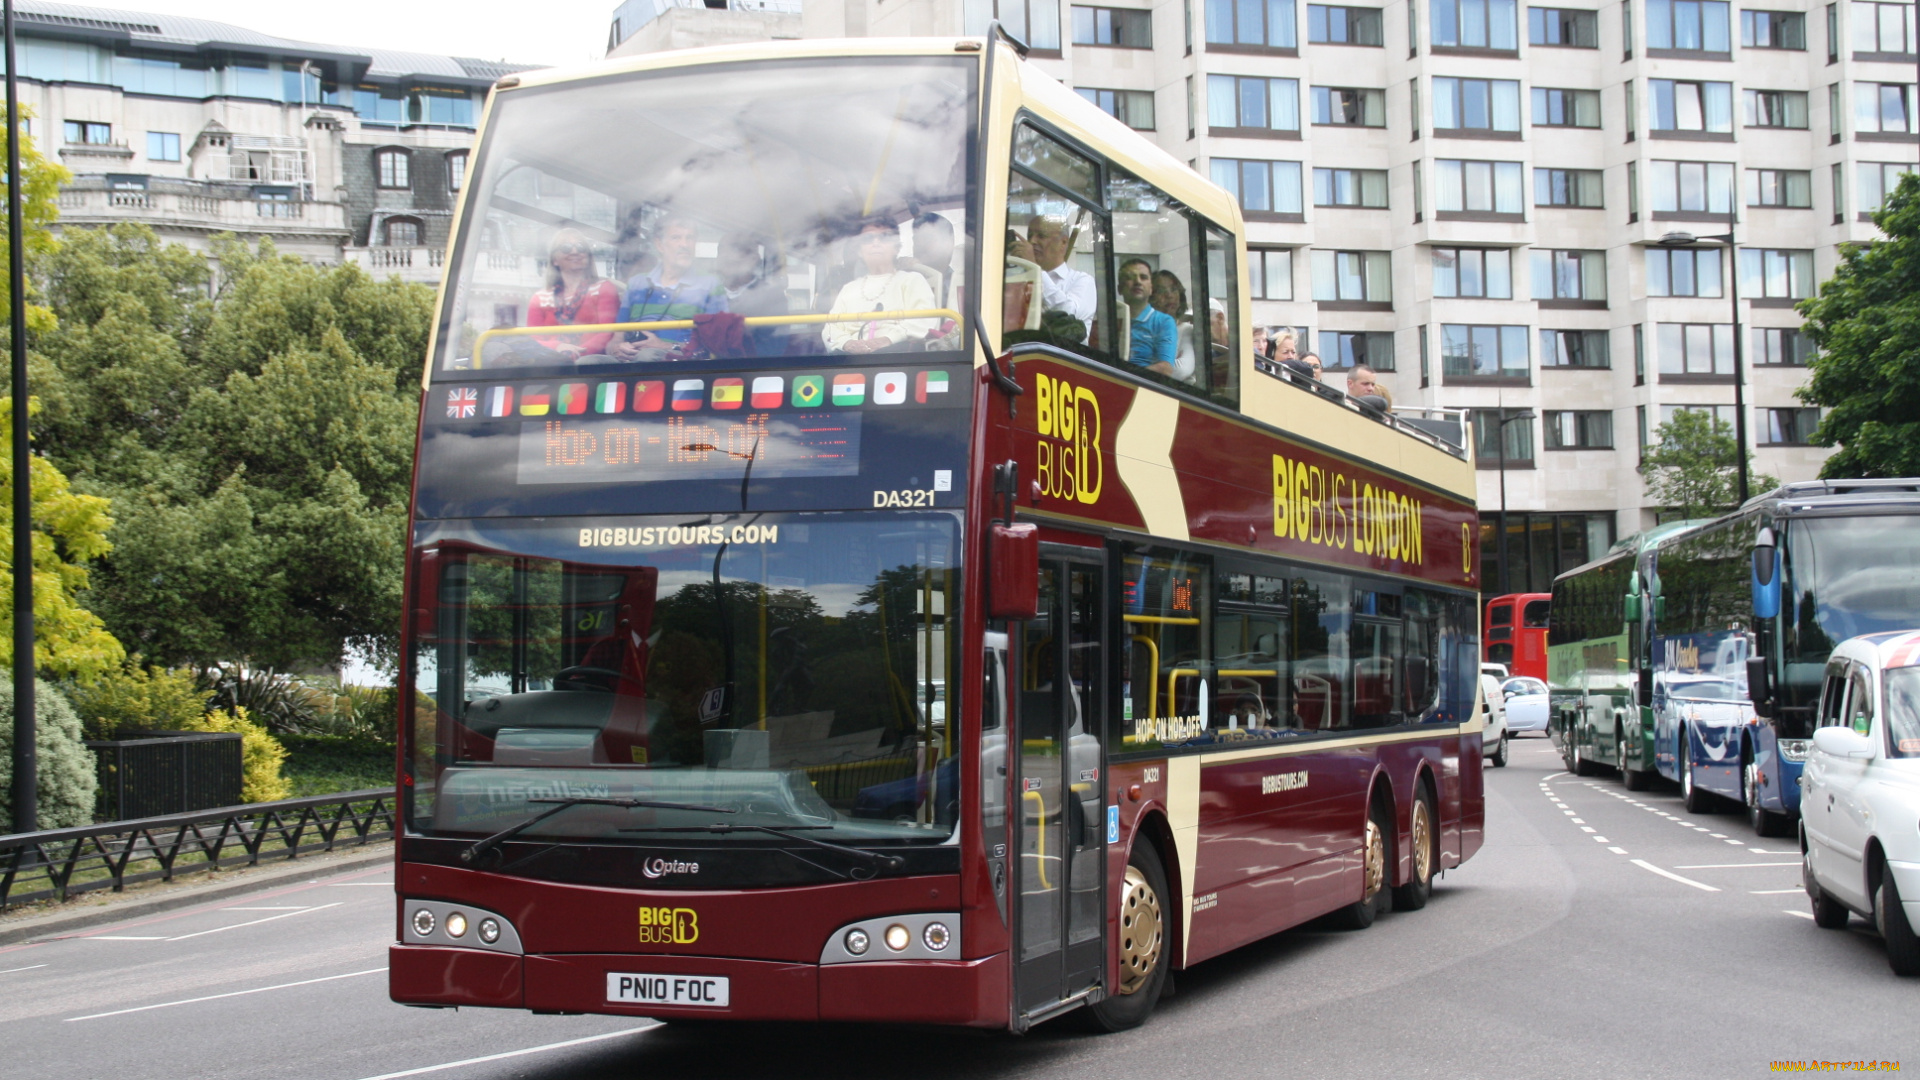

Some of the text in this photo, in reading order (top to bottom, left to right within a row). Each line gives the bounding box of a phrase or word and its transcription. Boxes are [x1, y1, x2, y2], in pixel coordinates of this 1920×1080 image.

[1036, 372, 1074, 441] BIG
[546, 420, 596, 466] Hop
[604, 427, 640, 464] on
[668, 416, 720, 463] Hop
[728, 413, 770, 461] off
[1038, 440, 1075, 501] BUS
[873, 490, 935, 508] DA321
[1352, 479, 1422, 566] LONDON
[579, 525, 778, 547] BIGBUSTOURS.COM
[1135, 717, 1167, 743] HOP-ON
[1144, 767, 1160, 783] DA321
[1262, 770, 1309, 795] BIGBUSTOURS.COM
[652, 858, 699, 876] Optare
[639, 907, 672, 926] BIG
[639, 925, 672, 943] BUS
[620, 976, 716, 1002] PN10 FOC
